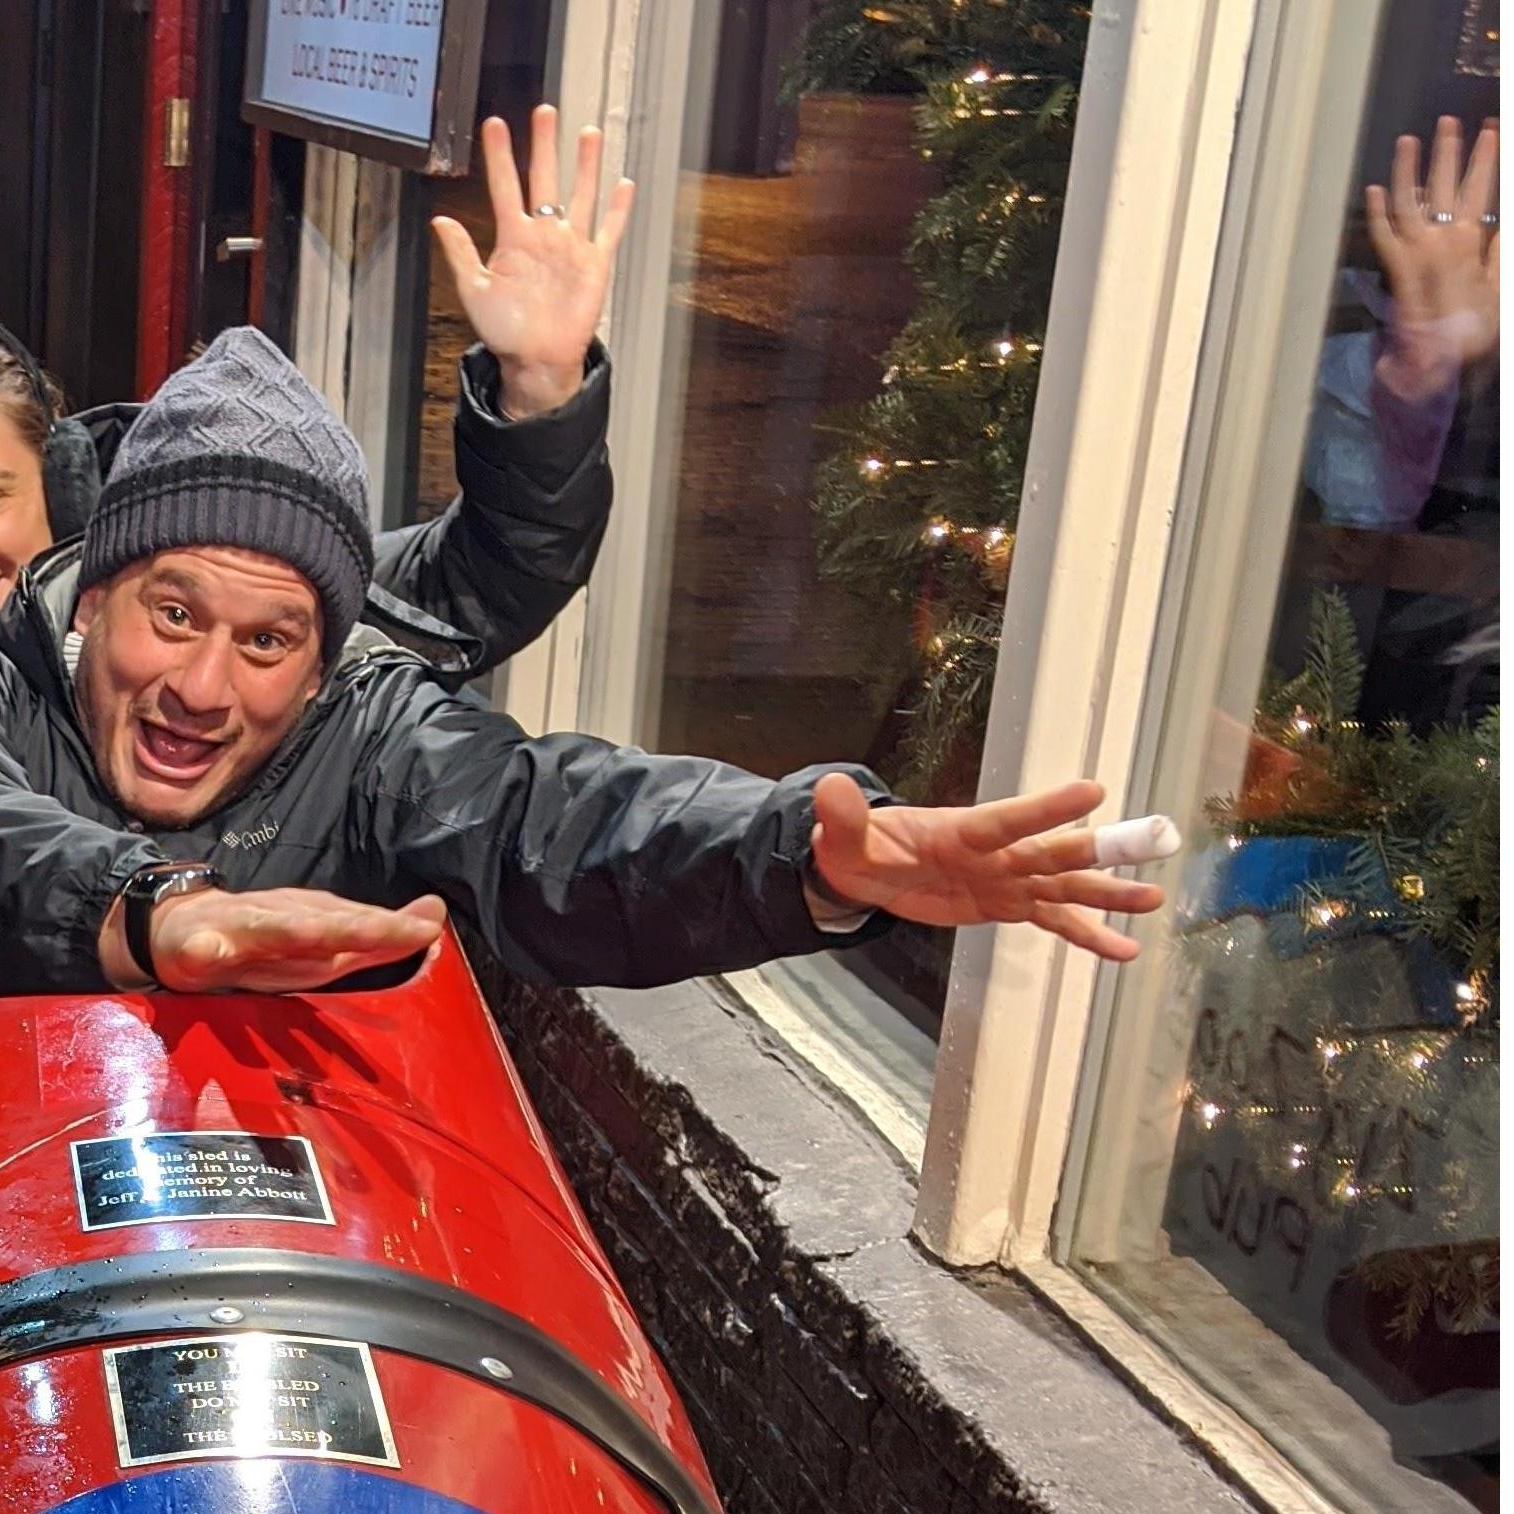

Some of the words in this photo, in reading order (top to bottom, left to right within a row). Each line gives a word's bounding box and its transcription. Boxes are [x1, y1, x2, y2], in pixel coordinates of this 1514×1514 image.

[326, 47, 359, 86] BEER
[369, 52, 419, 98] SPIRITS
[188, 1150, 228, 1162] sled
[234, 1150, 252, 1162] is
[203, 1163, 224, 1173] in
[229, 1162, 293, 1179] loving
[150, 1175, 228, 1188] emory
[233, 1174, 258, 1186] of
[97, 1192, 139, 1207] Jeff
[167, 1187, 233, 1200] Janine
[237, 1187, 308, 1201] Abbott
[173, 1348, 218, 1361] YOU
[278, 1347, 308, 1360] SIT
[173, 1380, 217, 1393] THE
[192, 1396, 224, 1409] DO
[277, 1396, 311, 1408] SIT
[183, 1431, 226, 1444] THE
